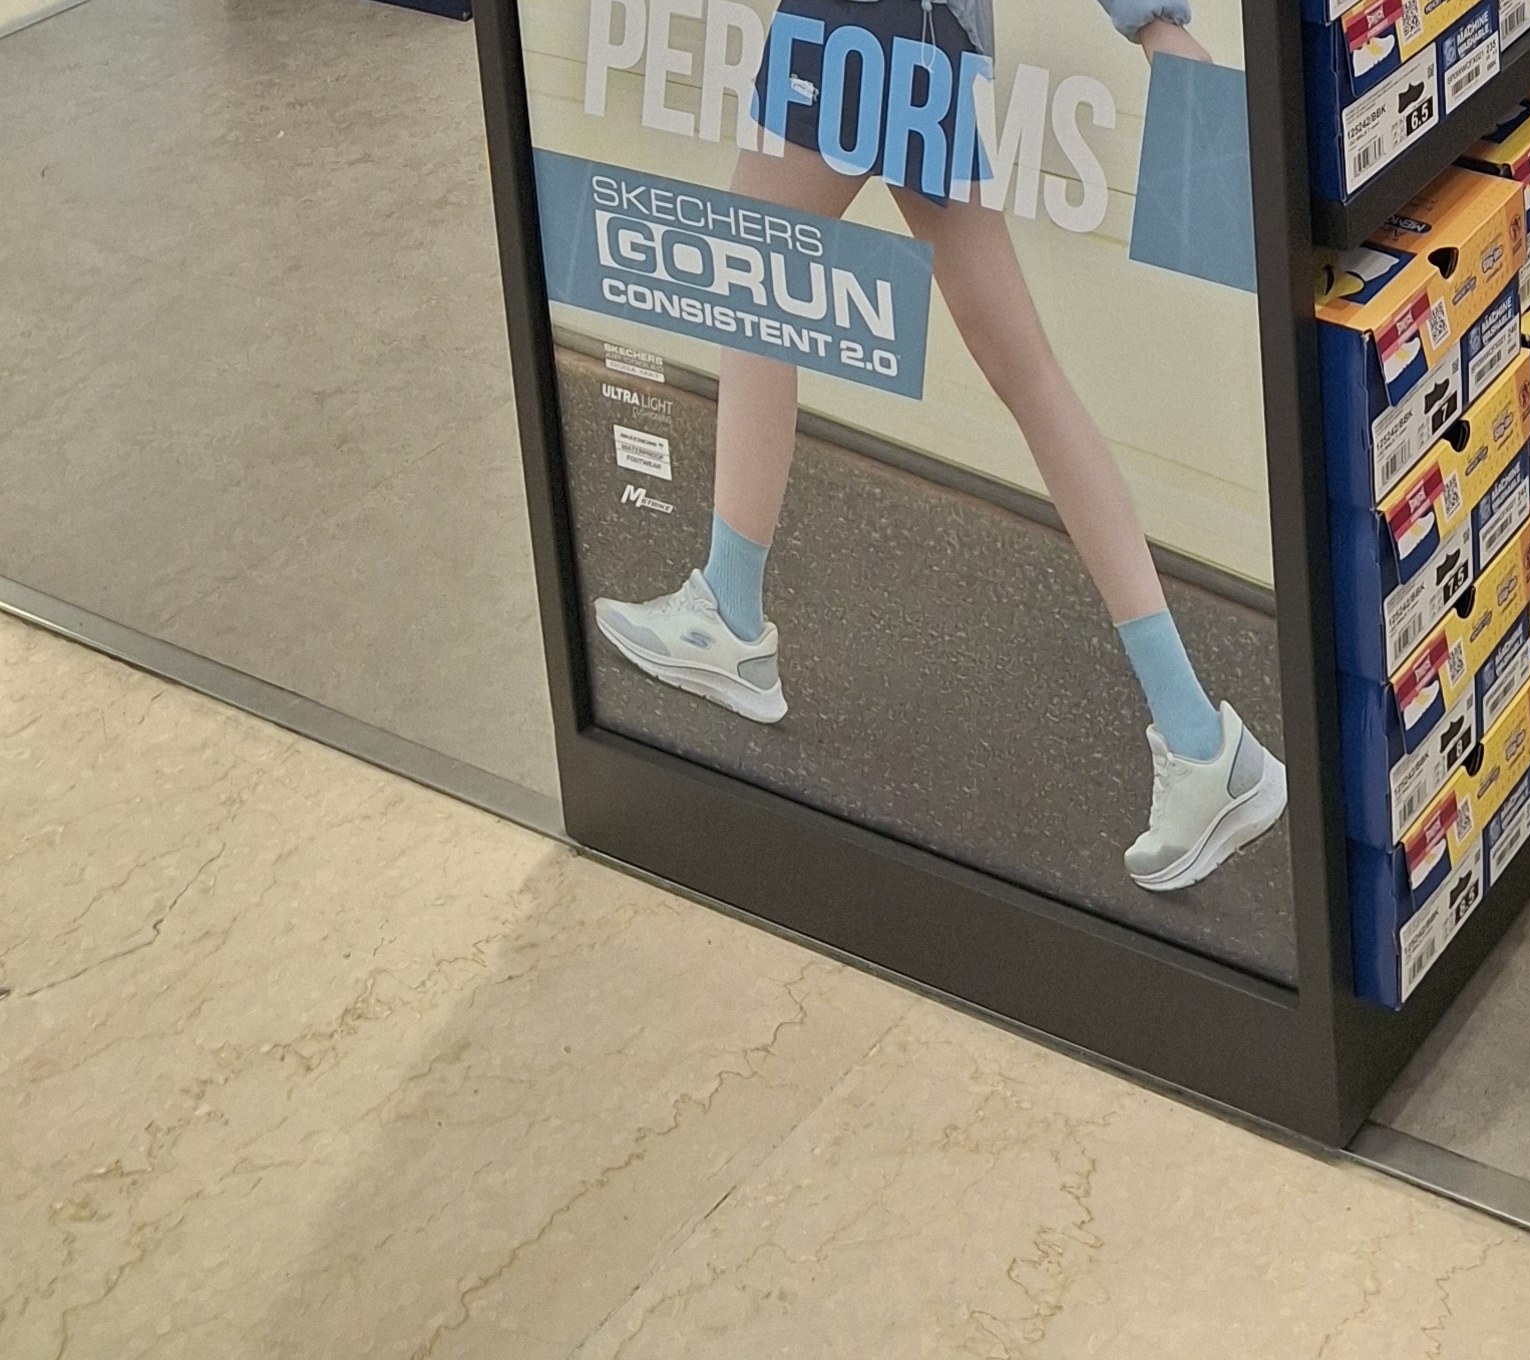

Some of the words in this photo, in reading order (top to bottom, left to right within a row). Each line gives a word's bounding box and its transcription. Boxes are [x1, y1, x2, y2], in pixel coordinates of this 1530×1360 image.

[1457, 10, 1490, 44] MACHINE
[1485, 39, 1497, 56] 235
[1347, 103, 1387, 141] 125242/BBK
[1410, 107, 1429, 130] 6.5
[591, 175, 824, 258] SKECHERS
[602, 276, 832, 359] CONSISTENT
[839, 336, 900, 379] 2.0
[603, 342, 664, 366] SKECHERS
[602, 382, 641, 407] ULTRA
[640, 395, 674, 415] LIGHT
[621, 443, 665, 461] WATERPROOF
[626, 454, 662, 471] FOOTWEAR
[1458, 887, 1477, 917] 8.5
